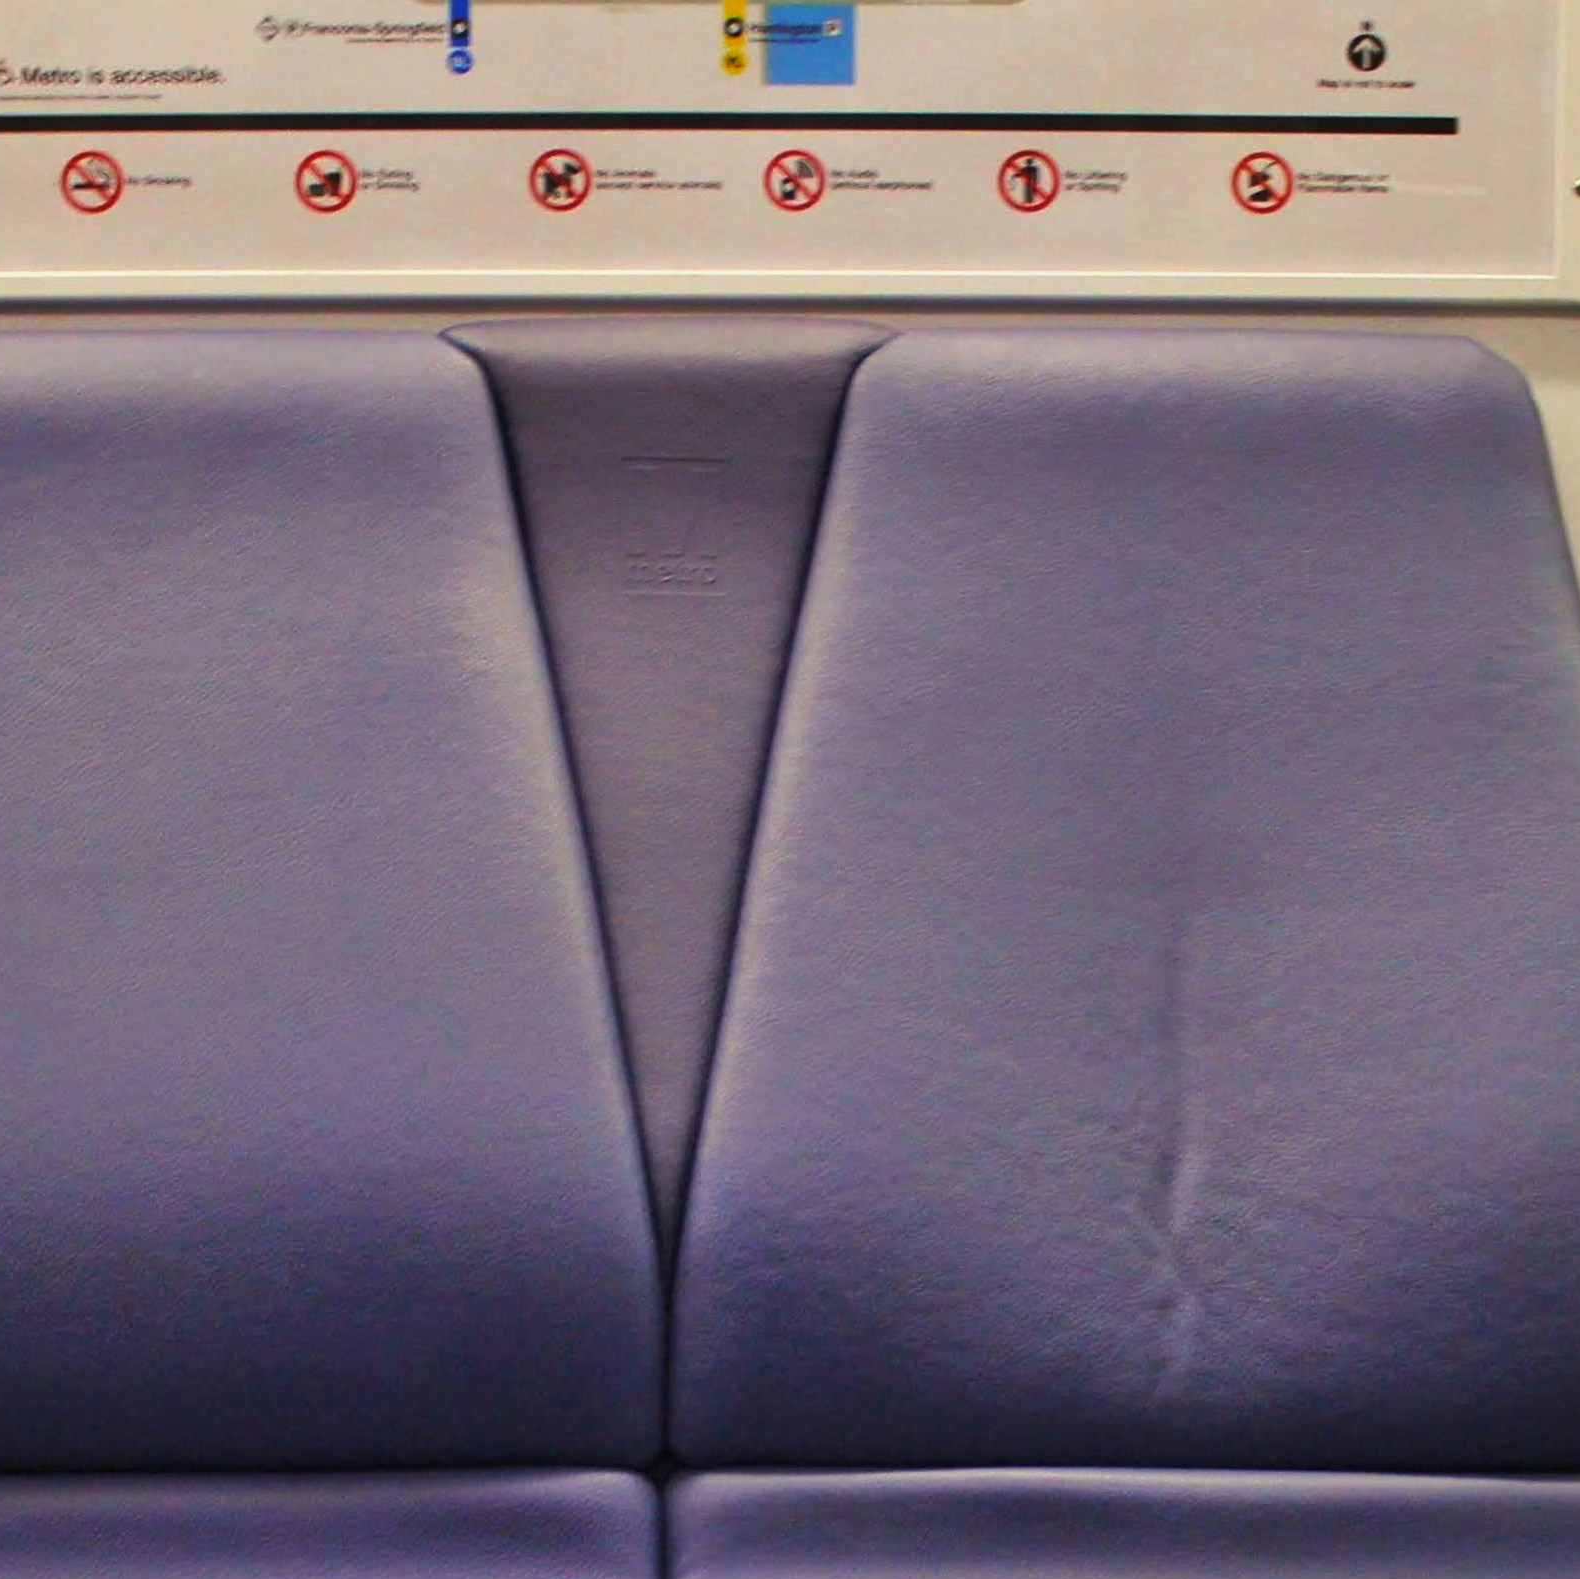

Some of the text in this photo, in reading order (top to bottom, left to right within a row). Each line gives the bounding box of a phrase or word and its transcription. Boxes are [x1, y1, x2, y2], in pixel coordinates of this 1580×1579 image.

[21, 66, 227, 85] Metro is accessible.
